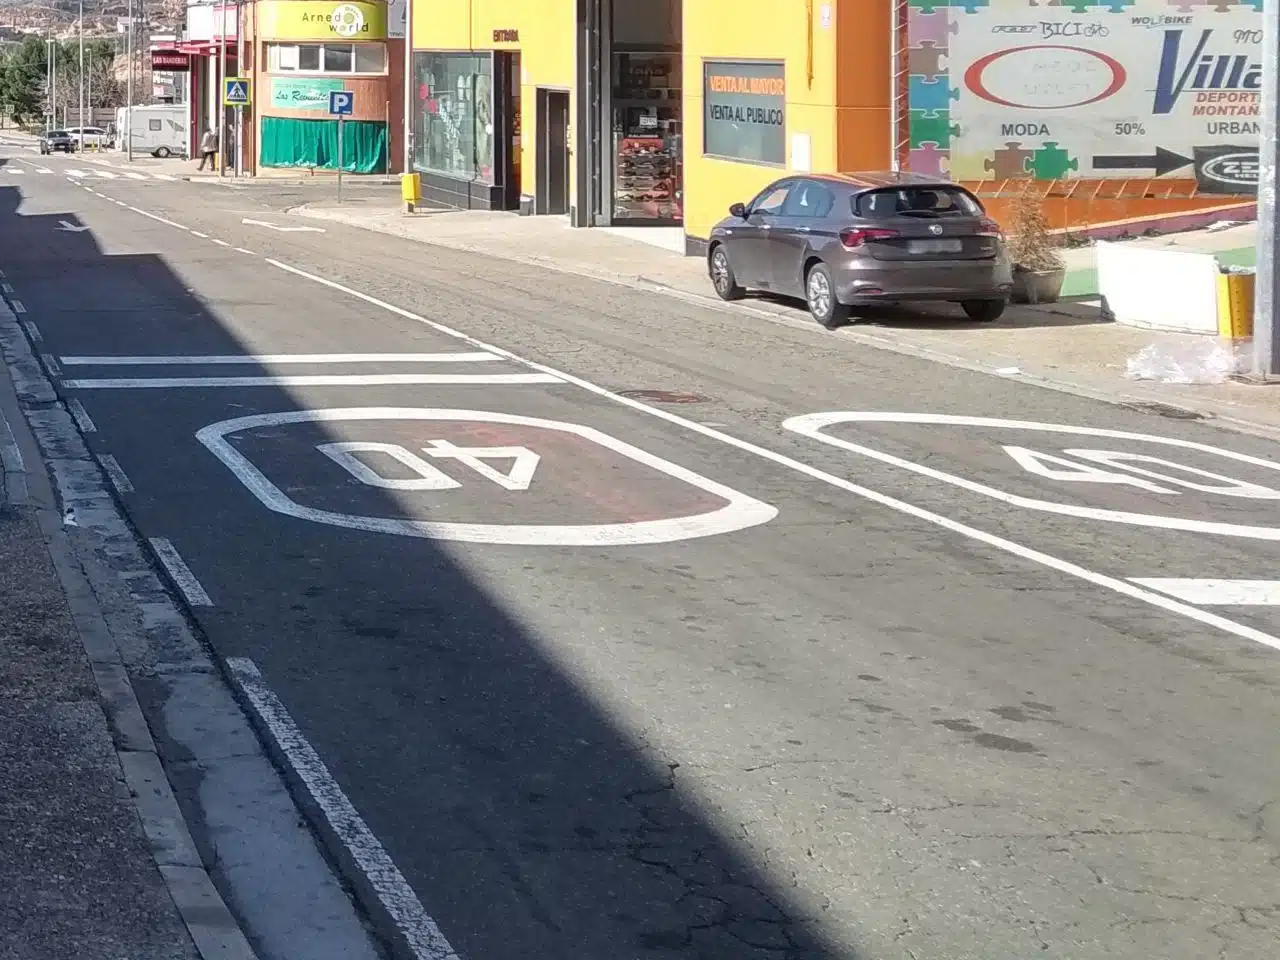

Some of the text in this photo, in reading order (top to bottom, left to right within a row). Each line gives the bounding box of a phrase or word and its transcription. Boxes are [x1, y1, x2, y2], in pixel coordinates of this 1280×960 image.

[329, 23, 369, 32] world
[710, 75, 737, 92] VENTA
[738, 77, 750, 93] AL
[334, 94, 349, 112] P
[1196, 92, 1261, 103] DEPORT
[710, 104, 783, 126] VENTA AL PUBLICO
[1001, 124, 1050, 136] MODA
[1115, 123, 1145, 135] 50%
[314, 439, 541, 490] 40
[1001, 445, 1280, 500] 40
